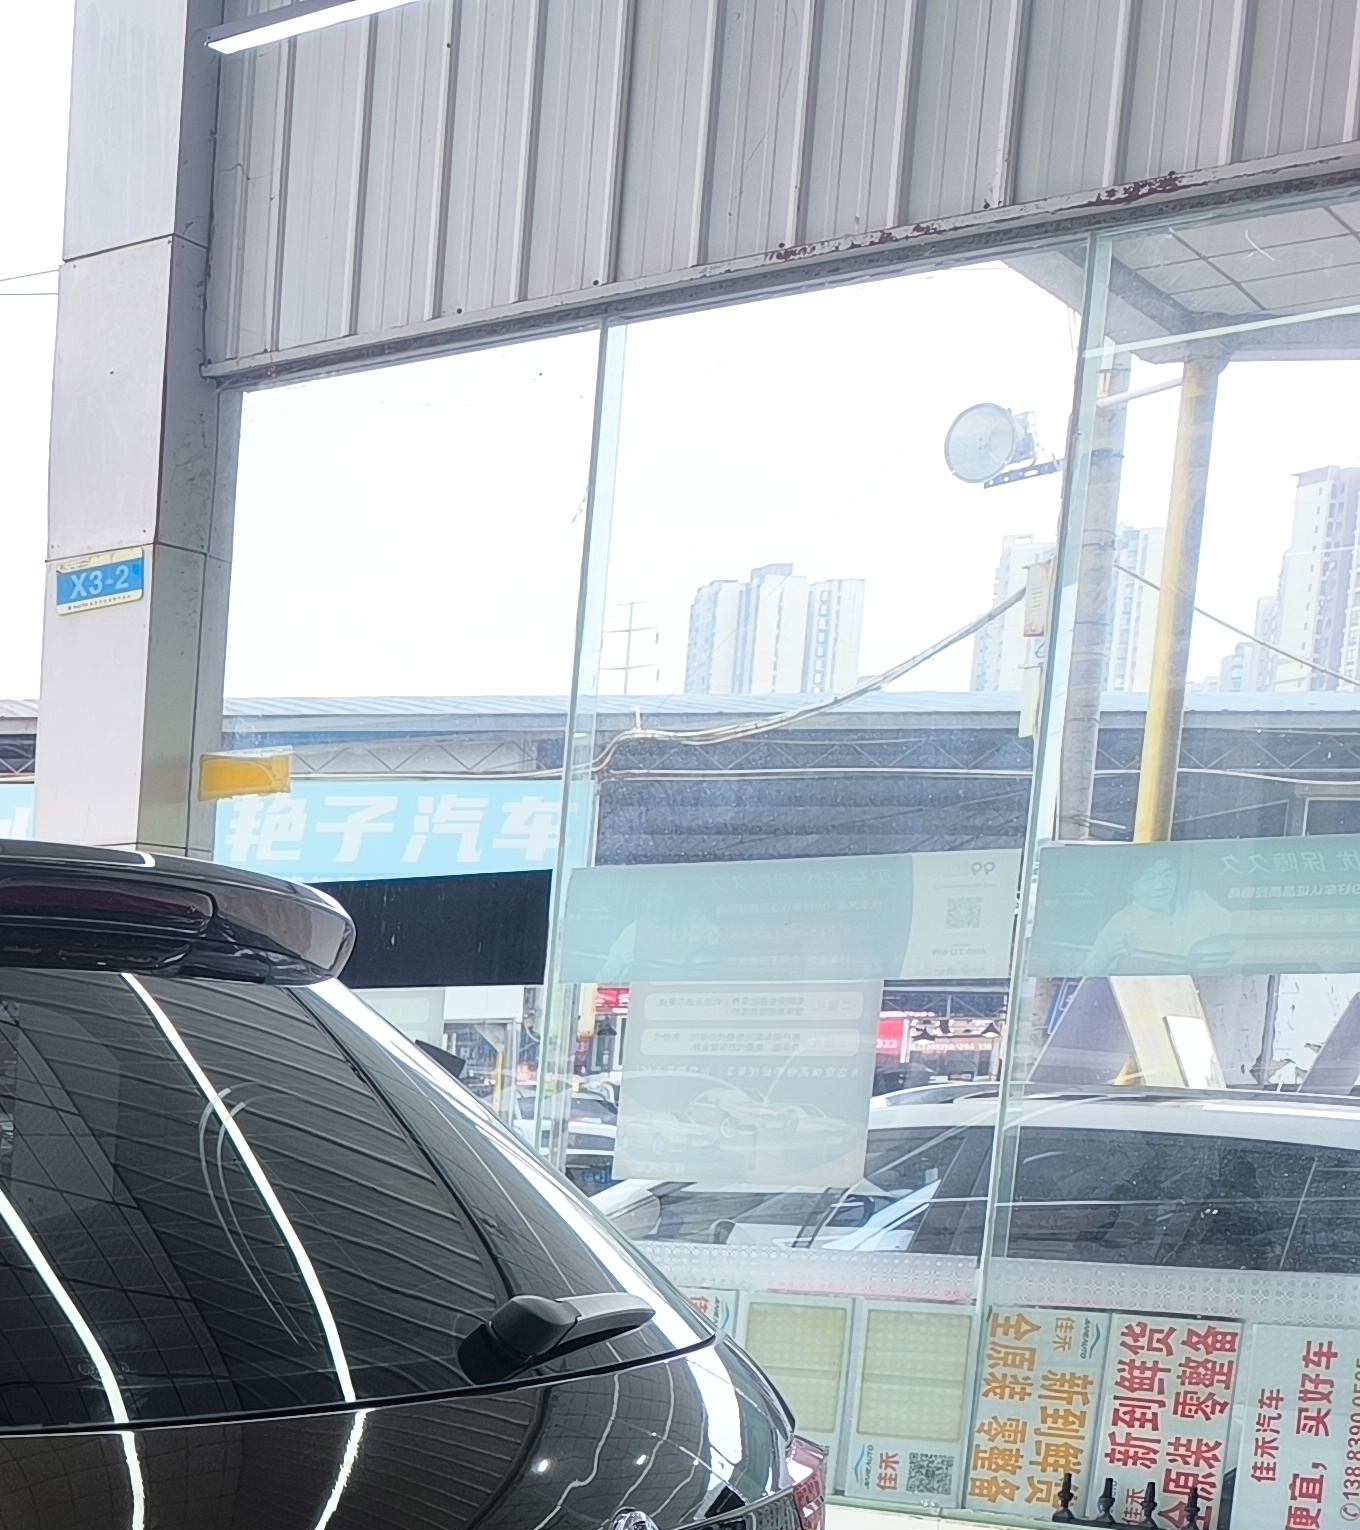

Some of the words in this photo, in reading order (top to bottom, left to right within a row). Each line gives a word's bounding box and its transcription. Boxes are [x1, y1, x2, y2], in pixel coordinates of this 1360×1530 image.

[70, 564, 130, 600] X3-2
[224, 793, 579, 864] 艳子汽车
[982, 1311, 1042, 1402] 全原装
[1103, 1320, 1178, 1470] 新到鲜货
[1172, 1324, 1240, 1422] 零整备
[876, 1452, 900, 1492] 佳禾
[968, 1414, 1029, 1505] 零整备
[1251, 1387, 1285, 1483] 佳禾汽车
